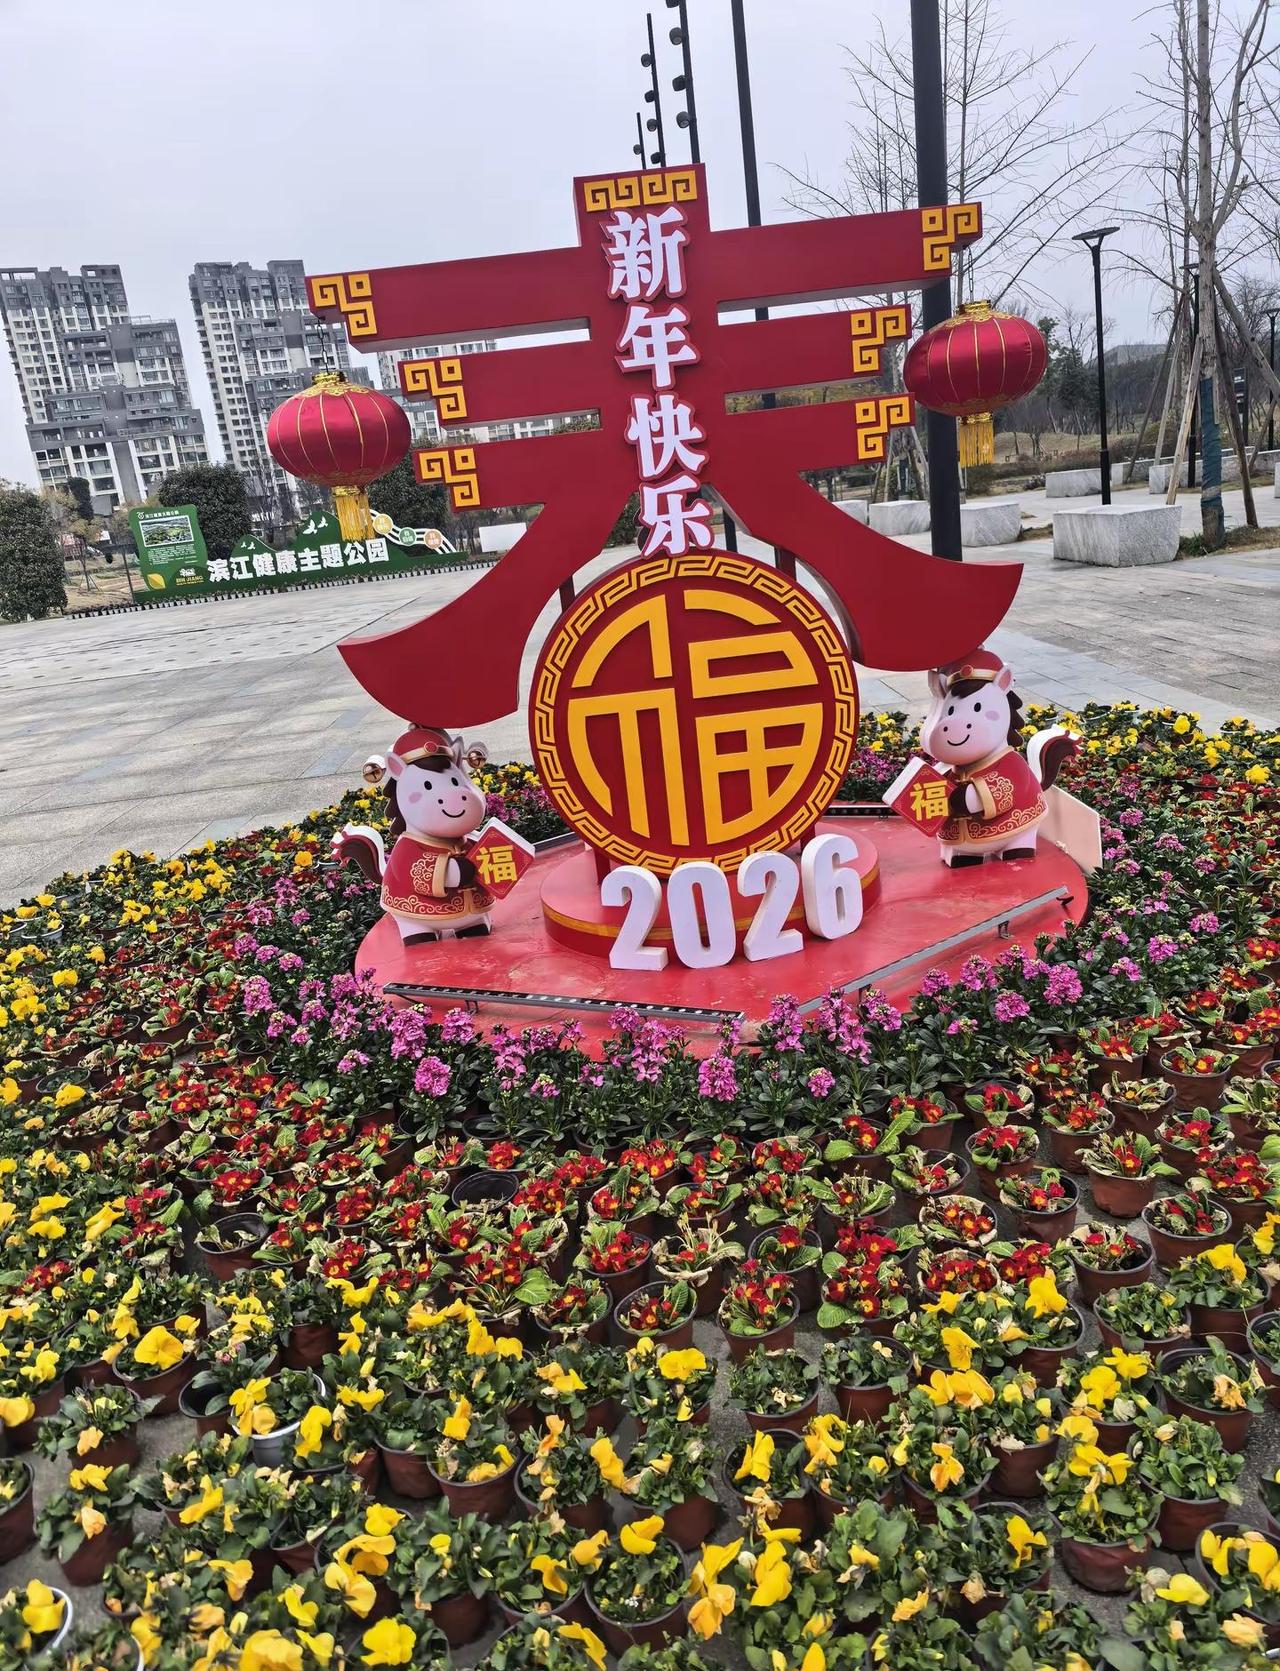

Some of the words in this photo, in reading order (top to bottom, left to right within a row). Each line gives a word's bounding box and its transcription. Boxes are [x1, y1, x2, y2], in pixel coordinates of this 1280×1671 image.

[603, 206, 714, 556] 新年快乐
[206, 537, 390, 582] 滨江健康主题公园
[567, 589, 824, 847] 福
[910, 779, 949, 821] 福
[476, 844, 518, 885] 福
[601, 833, 864, 971] 2026
